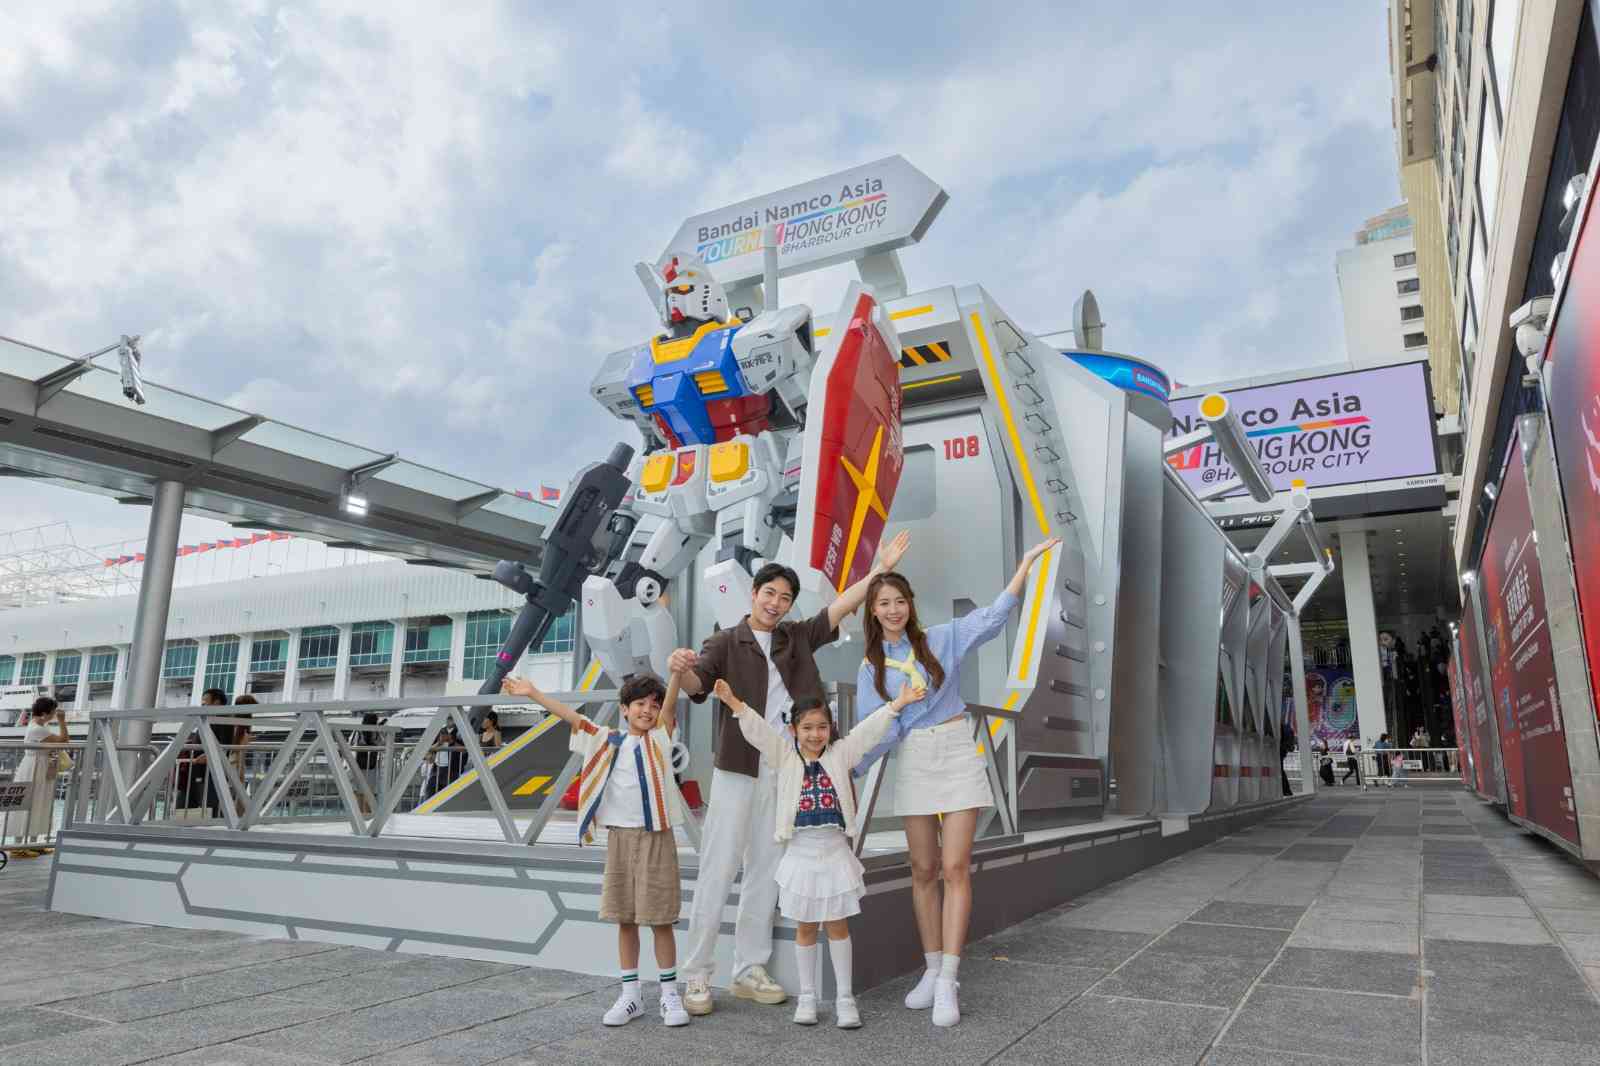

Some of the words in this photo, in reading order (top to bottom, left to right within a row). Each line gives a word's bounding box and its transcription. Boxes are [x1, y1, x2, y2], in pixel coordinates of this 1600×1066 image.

[698, 211, 759, 243] Bandai
[765, 194, 832, 223] Namco
[840, 178, 883, 202] Asia
[784, 216, 833, 243] HONG
[836, 200, 887, 228] KONG
[781, 227, 852, 256] @HARBOUR
[855, 218, 886, 234] CITY
[1172, 407, 1278, 437] Nco
[1290, 392, 1361, 420] Asia
[943, 435, 979, 460] 108
[1202, 457, 1315, 483] @HBOUR
[1322, 450, 1369, 468] CITY
[1203, 437, 1283, 467] HNG
[1290, 425, 1371, 456] KONG
